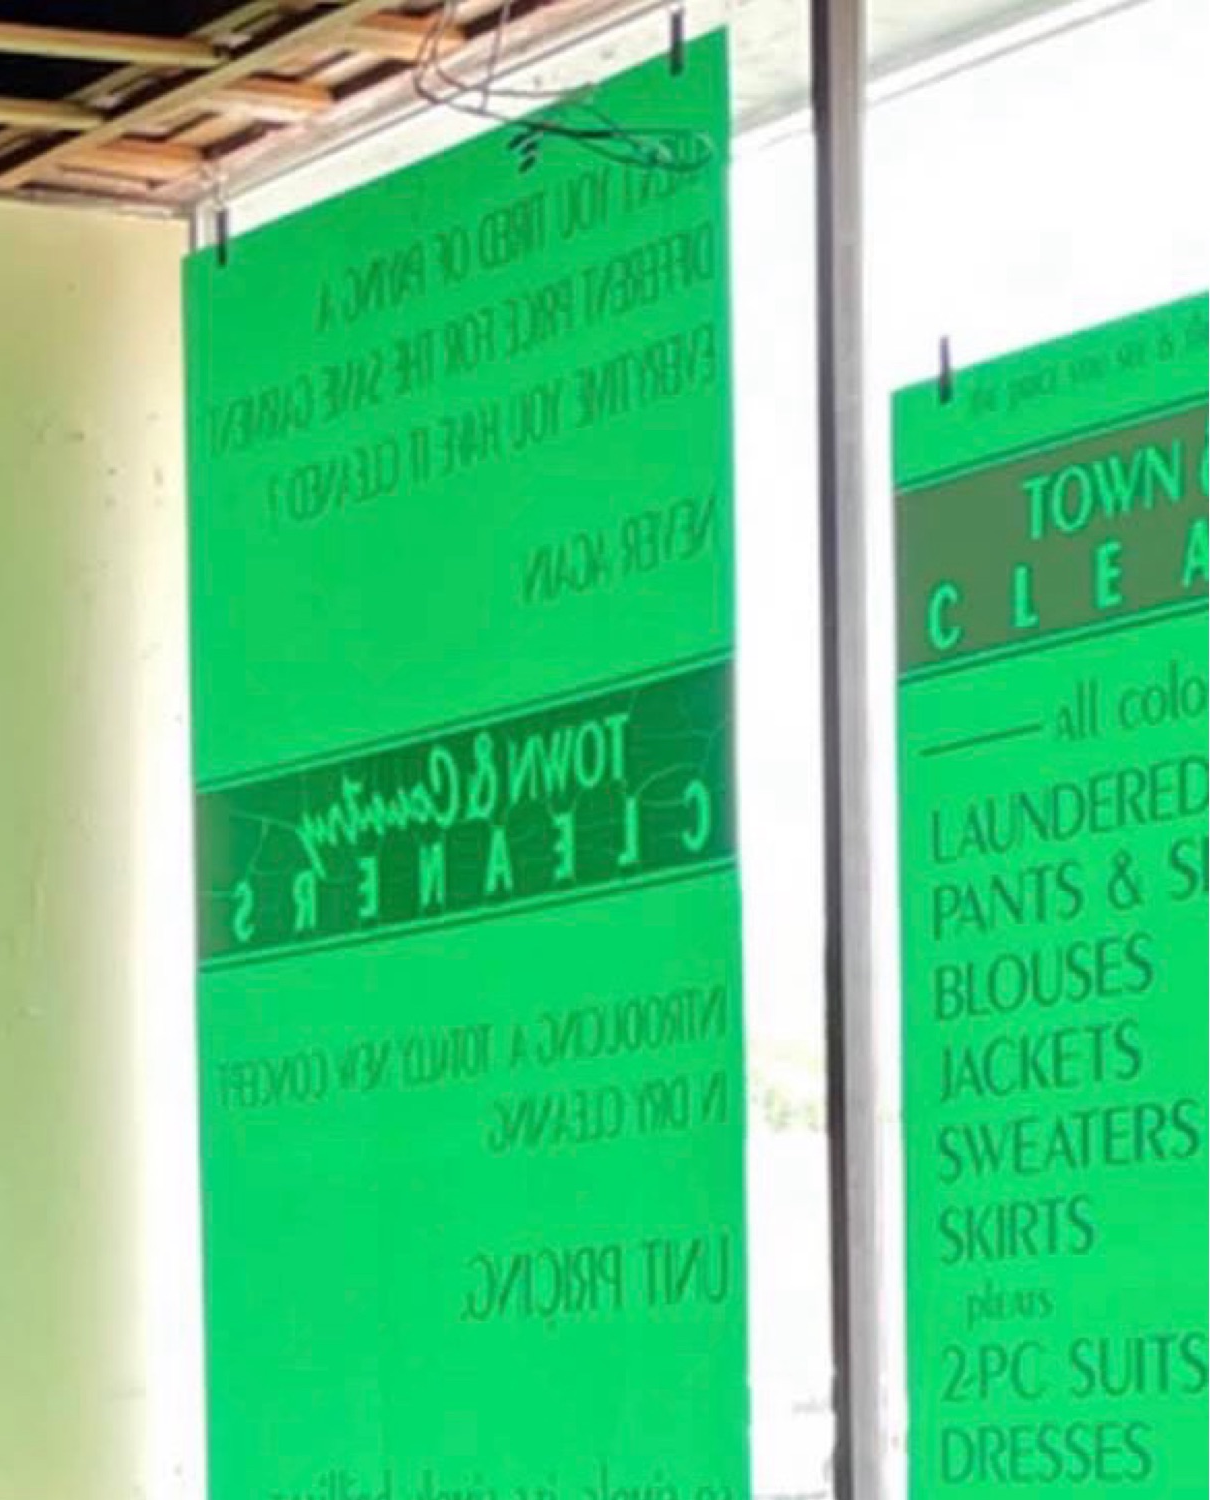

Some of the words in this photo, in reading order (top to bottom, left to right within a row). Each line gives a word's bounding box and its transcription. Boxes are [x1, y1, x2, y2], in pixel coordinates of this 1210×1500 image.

[1022, 440, 1185, 540] TOWN
[1054, 679, 1099, 741] all
[1118, 659, 1209, 730] colo
[932, 755, 1209, 865] LAUNDERED
[932, 858, 1086, 941] PANTS
[1107, 848, 1144, 911] &
[1168, 834, 1209, 902] S
[934, 930, 1154, 1021] BLOUSES
[941, 1017, 1142, 1104] JACKETS
[938, 1097, 1200, 1185] SWEATERS
[940, 1194, 1095, 1265] SKIRTS
[942, 1340, 1048, 1402] 2PC
[1069, 1331, 1209, 1398] SUITS
[941, 1420, 1152, 1485] DRESSES
